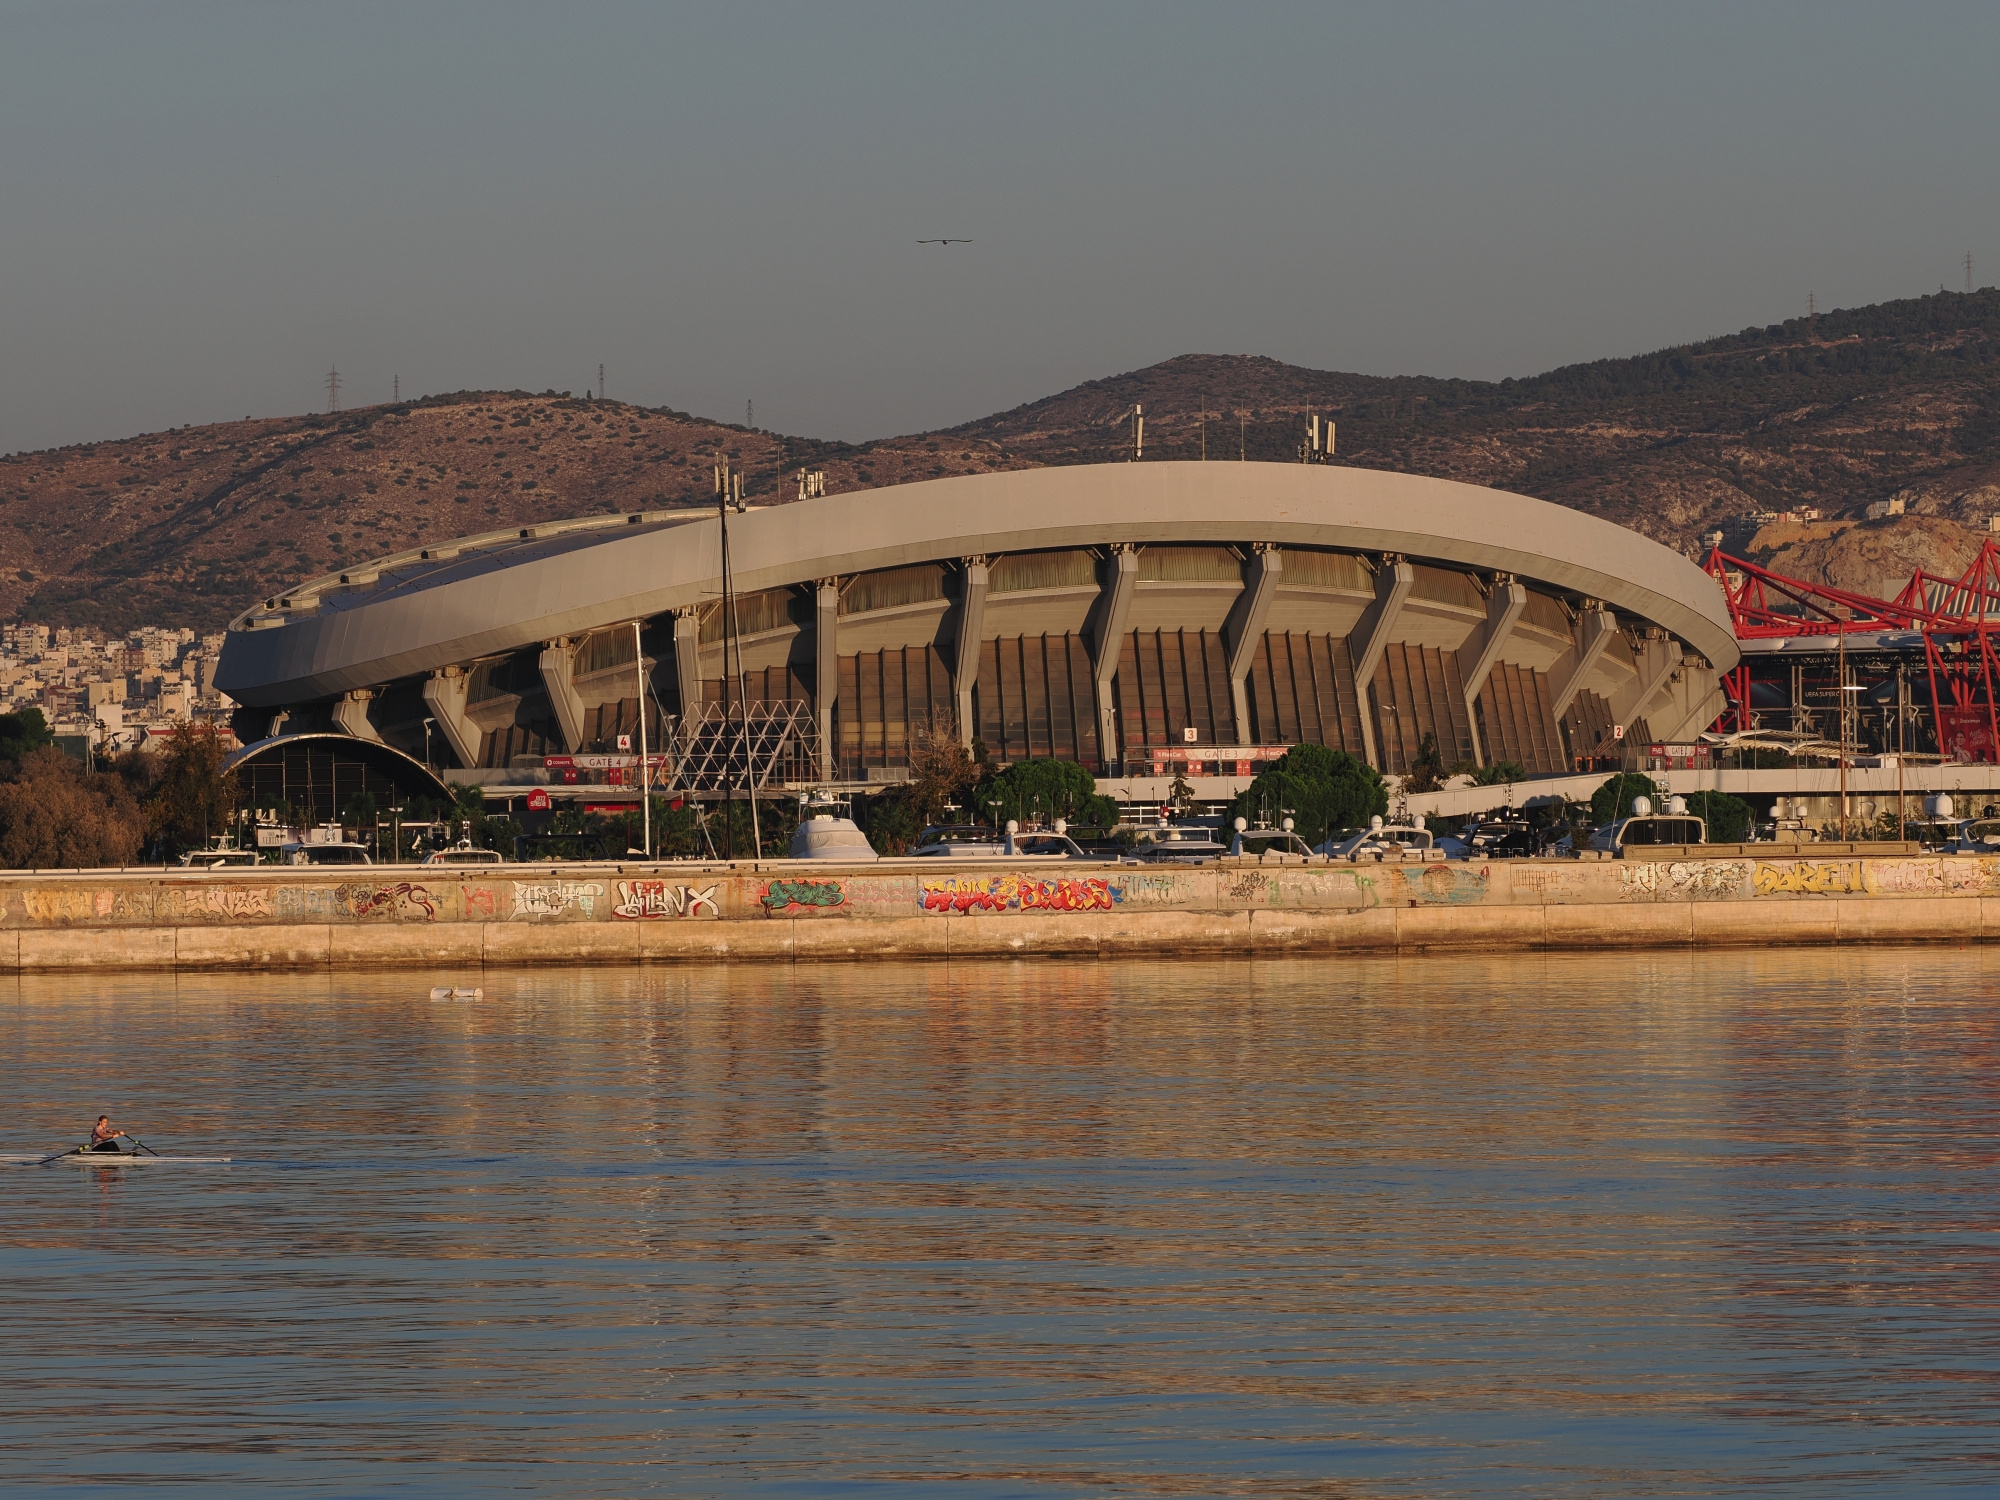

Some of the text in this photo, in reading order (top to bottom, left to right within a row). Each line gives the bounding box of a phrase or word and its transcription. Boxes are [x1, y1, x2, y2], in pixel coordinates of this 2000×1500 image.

[1188, 730, 1194, 739] 3
[1616, 727, 1621, 736] 2
[620, 736, 627, 746] 4
[1204, 750, 1238, 758] GATE 3
[1671, 746, 1684, 755] GATE
[589, 758, 621, 767] GATE 4
